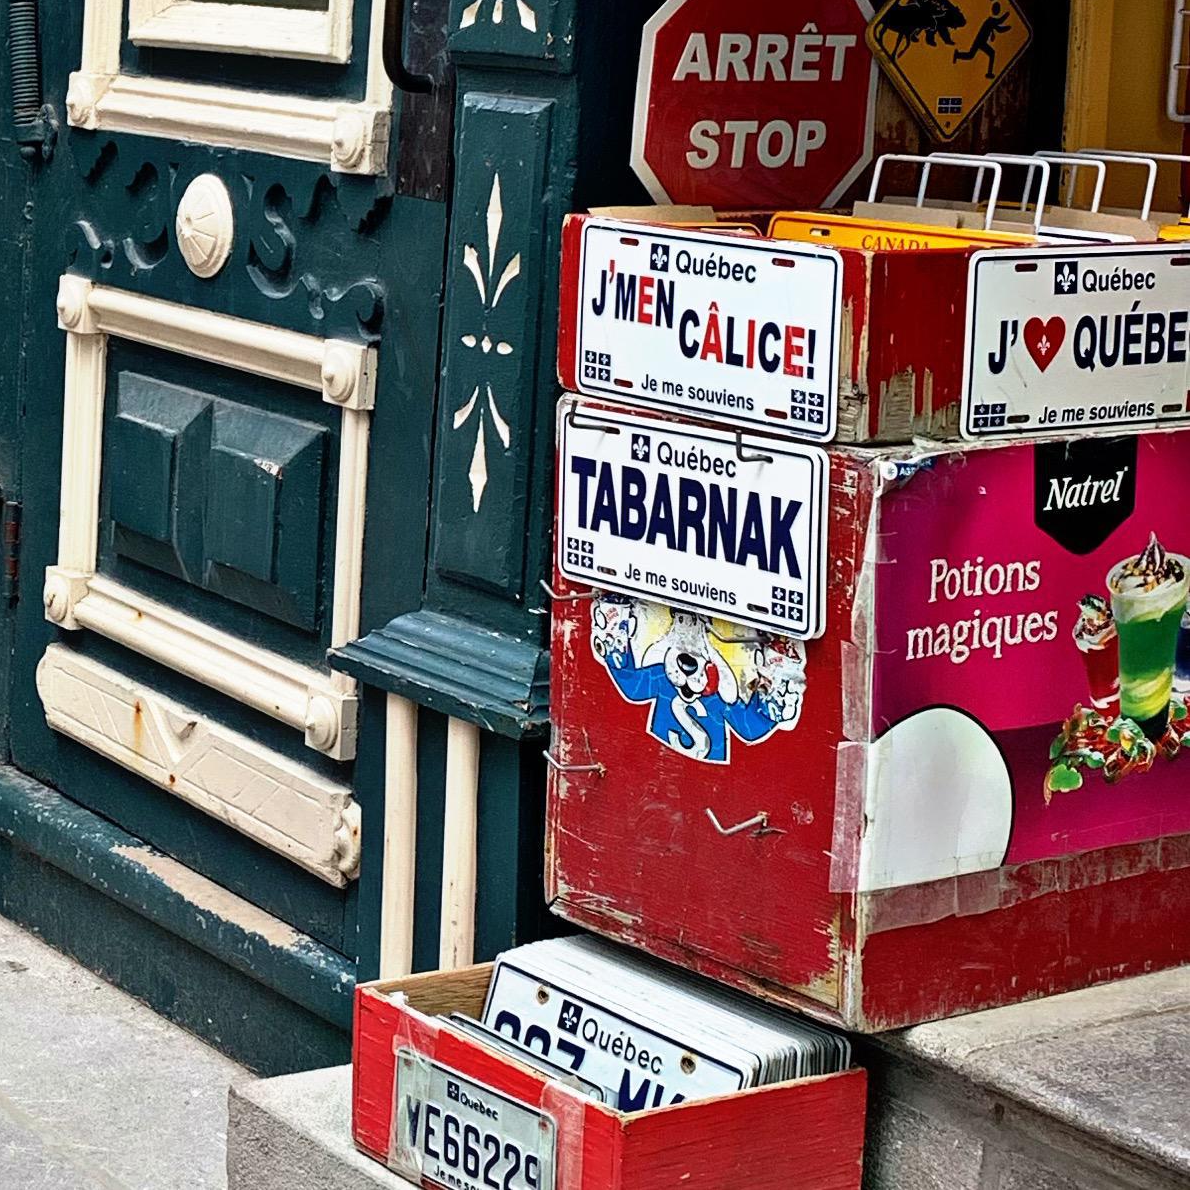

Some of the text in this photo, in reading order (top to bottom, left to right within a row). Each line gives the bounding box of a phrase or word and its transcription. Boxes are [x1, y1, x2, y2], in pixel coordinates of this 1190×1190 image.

[672, 22, 857, 82] ARRÊT
[685, 119, 827, 170] STOP
[675, 249, 757, 284] Québec
[1081, 266, 1156, 293] Québec
[591, 259, 816, 380] J'MEN CÂLICE!
[987, 300, 1190, 376] J' QUÉBE
[641, 373, 755, 411] Je me souviens
[1038, 400, 1155, 425] Je me souviens
[656, 440, 737, 479] Québec
[1042, 467, 1128, 511] Natrel
[570, 454, 803, 580] TABARNAK
[624, 562, 737, 606] Je me souviens
[927, 556, 1041, 603] Potions
[905, 609, 1058, 665] magiques
[581, 1017, 663, 1075] Québec
